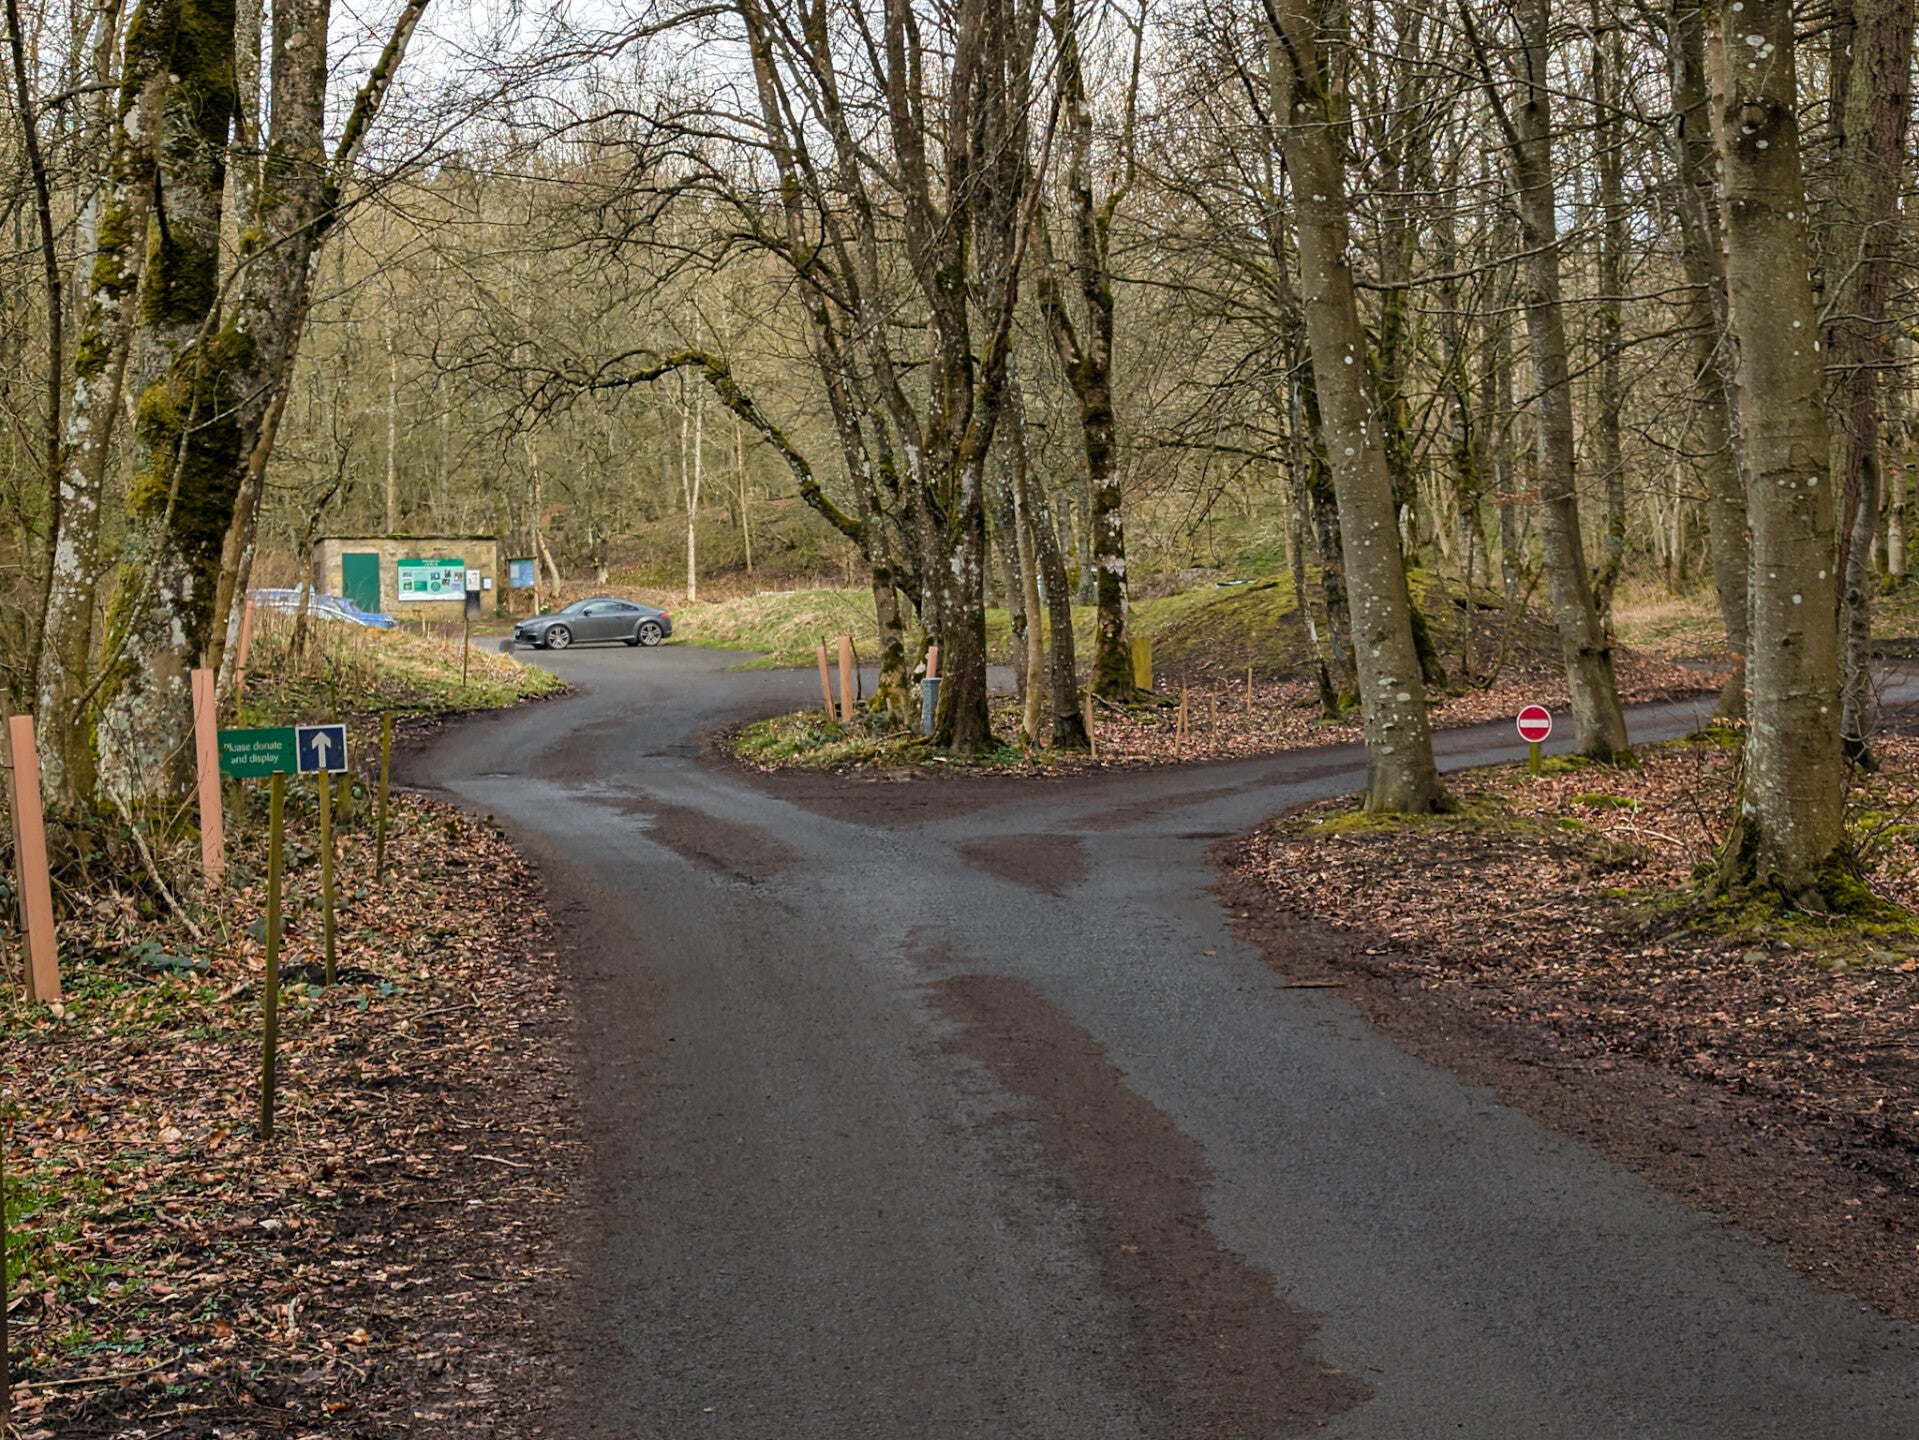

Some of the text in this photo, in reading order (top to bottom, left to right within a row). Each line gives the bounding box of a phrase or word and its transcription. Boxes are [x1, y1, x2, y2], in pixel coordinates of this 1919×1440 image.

[223, 741, 283, 752] Please donate
[230, 753, 279, 765] and display
